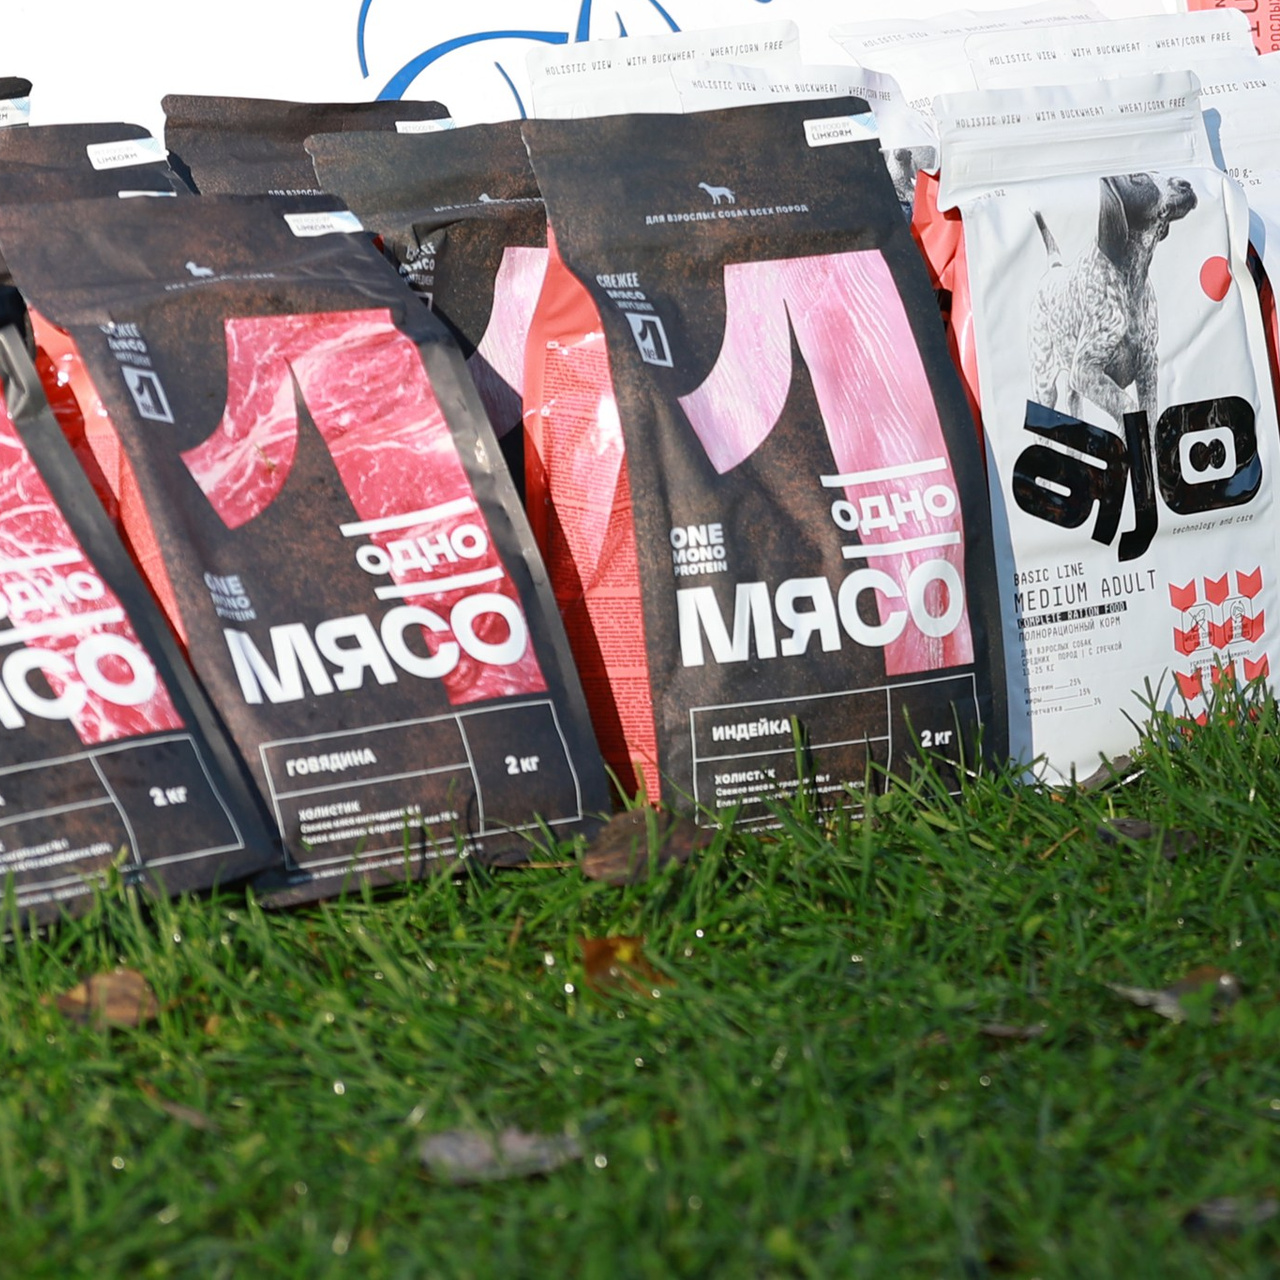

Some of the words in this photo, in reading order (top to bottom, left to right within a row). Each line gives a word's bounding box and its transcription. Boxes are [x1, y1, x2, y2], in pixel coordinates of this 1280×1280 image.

[545, 62, 587, 76] HOLISTIC
[591, 60, 613, 71] VIEW
[626, 56, 648, 66] WITH
[652, 49, 696, 64] BUCKWHEAT
[710, 42, 760, 57] WHEAT/CORN
[764, 39, 784, 51] FREE
[988, 53, 1033, 66] HOLISTIC
[1037, 49, 1058, 61] VIEW
[1072, 45, 1092, 57] WITH
[1096, 41, 1141, 55] BUCKWHEAT
[1155, 35, 1207, 49] WHEAT/CORN
[1211, 31, 1232, 42] FREE
[1242, 78, 1267, 90] VIEW
[955, 114, 998, 129] HOLISTIC
[1000, 113, 1022, 125] VIEW
[1035, 109, 1056, 121] WITH
[1059, 104, 1105, 119] BUCKWHEAT
[1118, 99, 1166, 114] WHEAT/CORN
[1168, 96, 1187, 108] FREE
[811, 129, 852, 141] LIMKORM
[645, 215, 665, 226] ДЛЯ
[667, 211, 717, 223] ВЗРОСЛЫХ
[718, 208, 749, 219] СОБАК
[750, 206, 775, 217] ВСЕХ
[775, 204, 809, 215] ПОРОД
[596, 272, 640, 288] СВЕЖЕЕ
[606, 289, 646, 301] МЯСО
[1172, 519, 1217, 535] technology
[1219, 516, 1234, 528] and
[1236, 513, 1254, 524] care
[670, 523, 724, 549] ONE
[673, 545, 726, 564] MONO
[674, 561, 728, 577] PROTEIN
[1013, 568, 1050, 587] BASIC
[1057, 562, 1085, 579] LINE
[1014, 581, 1088, 613] MEDIUM
[1101, 569, 1156, 599] ADULT
[676, 558, 964, 668] МЯСО
[1018, 612, 1063, 629] COMPLETE
[1067, 606, 1100, 620] RATION
[1104, 601, 1125, 614] FOOD
[1019, 619, 1096, 642] ПОЛНОРАЦИОННЫЙ
[1100, 616, 1121, 629] КОРМ
[224, 592, 528, 705] МЯСО
[1073, 638, 1093, 648] СОБАК
[1058, 650, 1078, 661] ПОРОД
[712, 716, 792, 742] ИНДЕЙКА
[920, 730, 933, 748] 2
[286, 747, 378, 777] ГОВЯДИНА
[505, 756, 519, 775] 2
[149, 786, 168, 807] 2
[298, 800, 362, 821] ХОЛИСТИК
